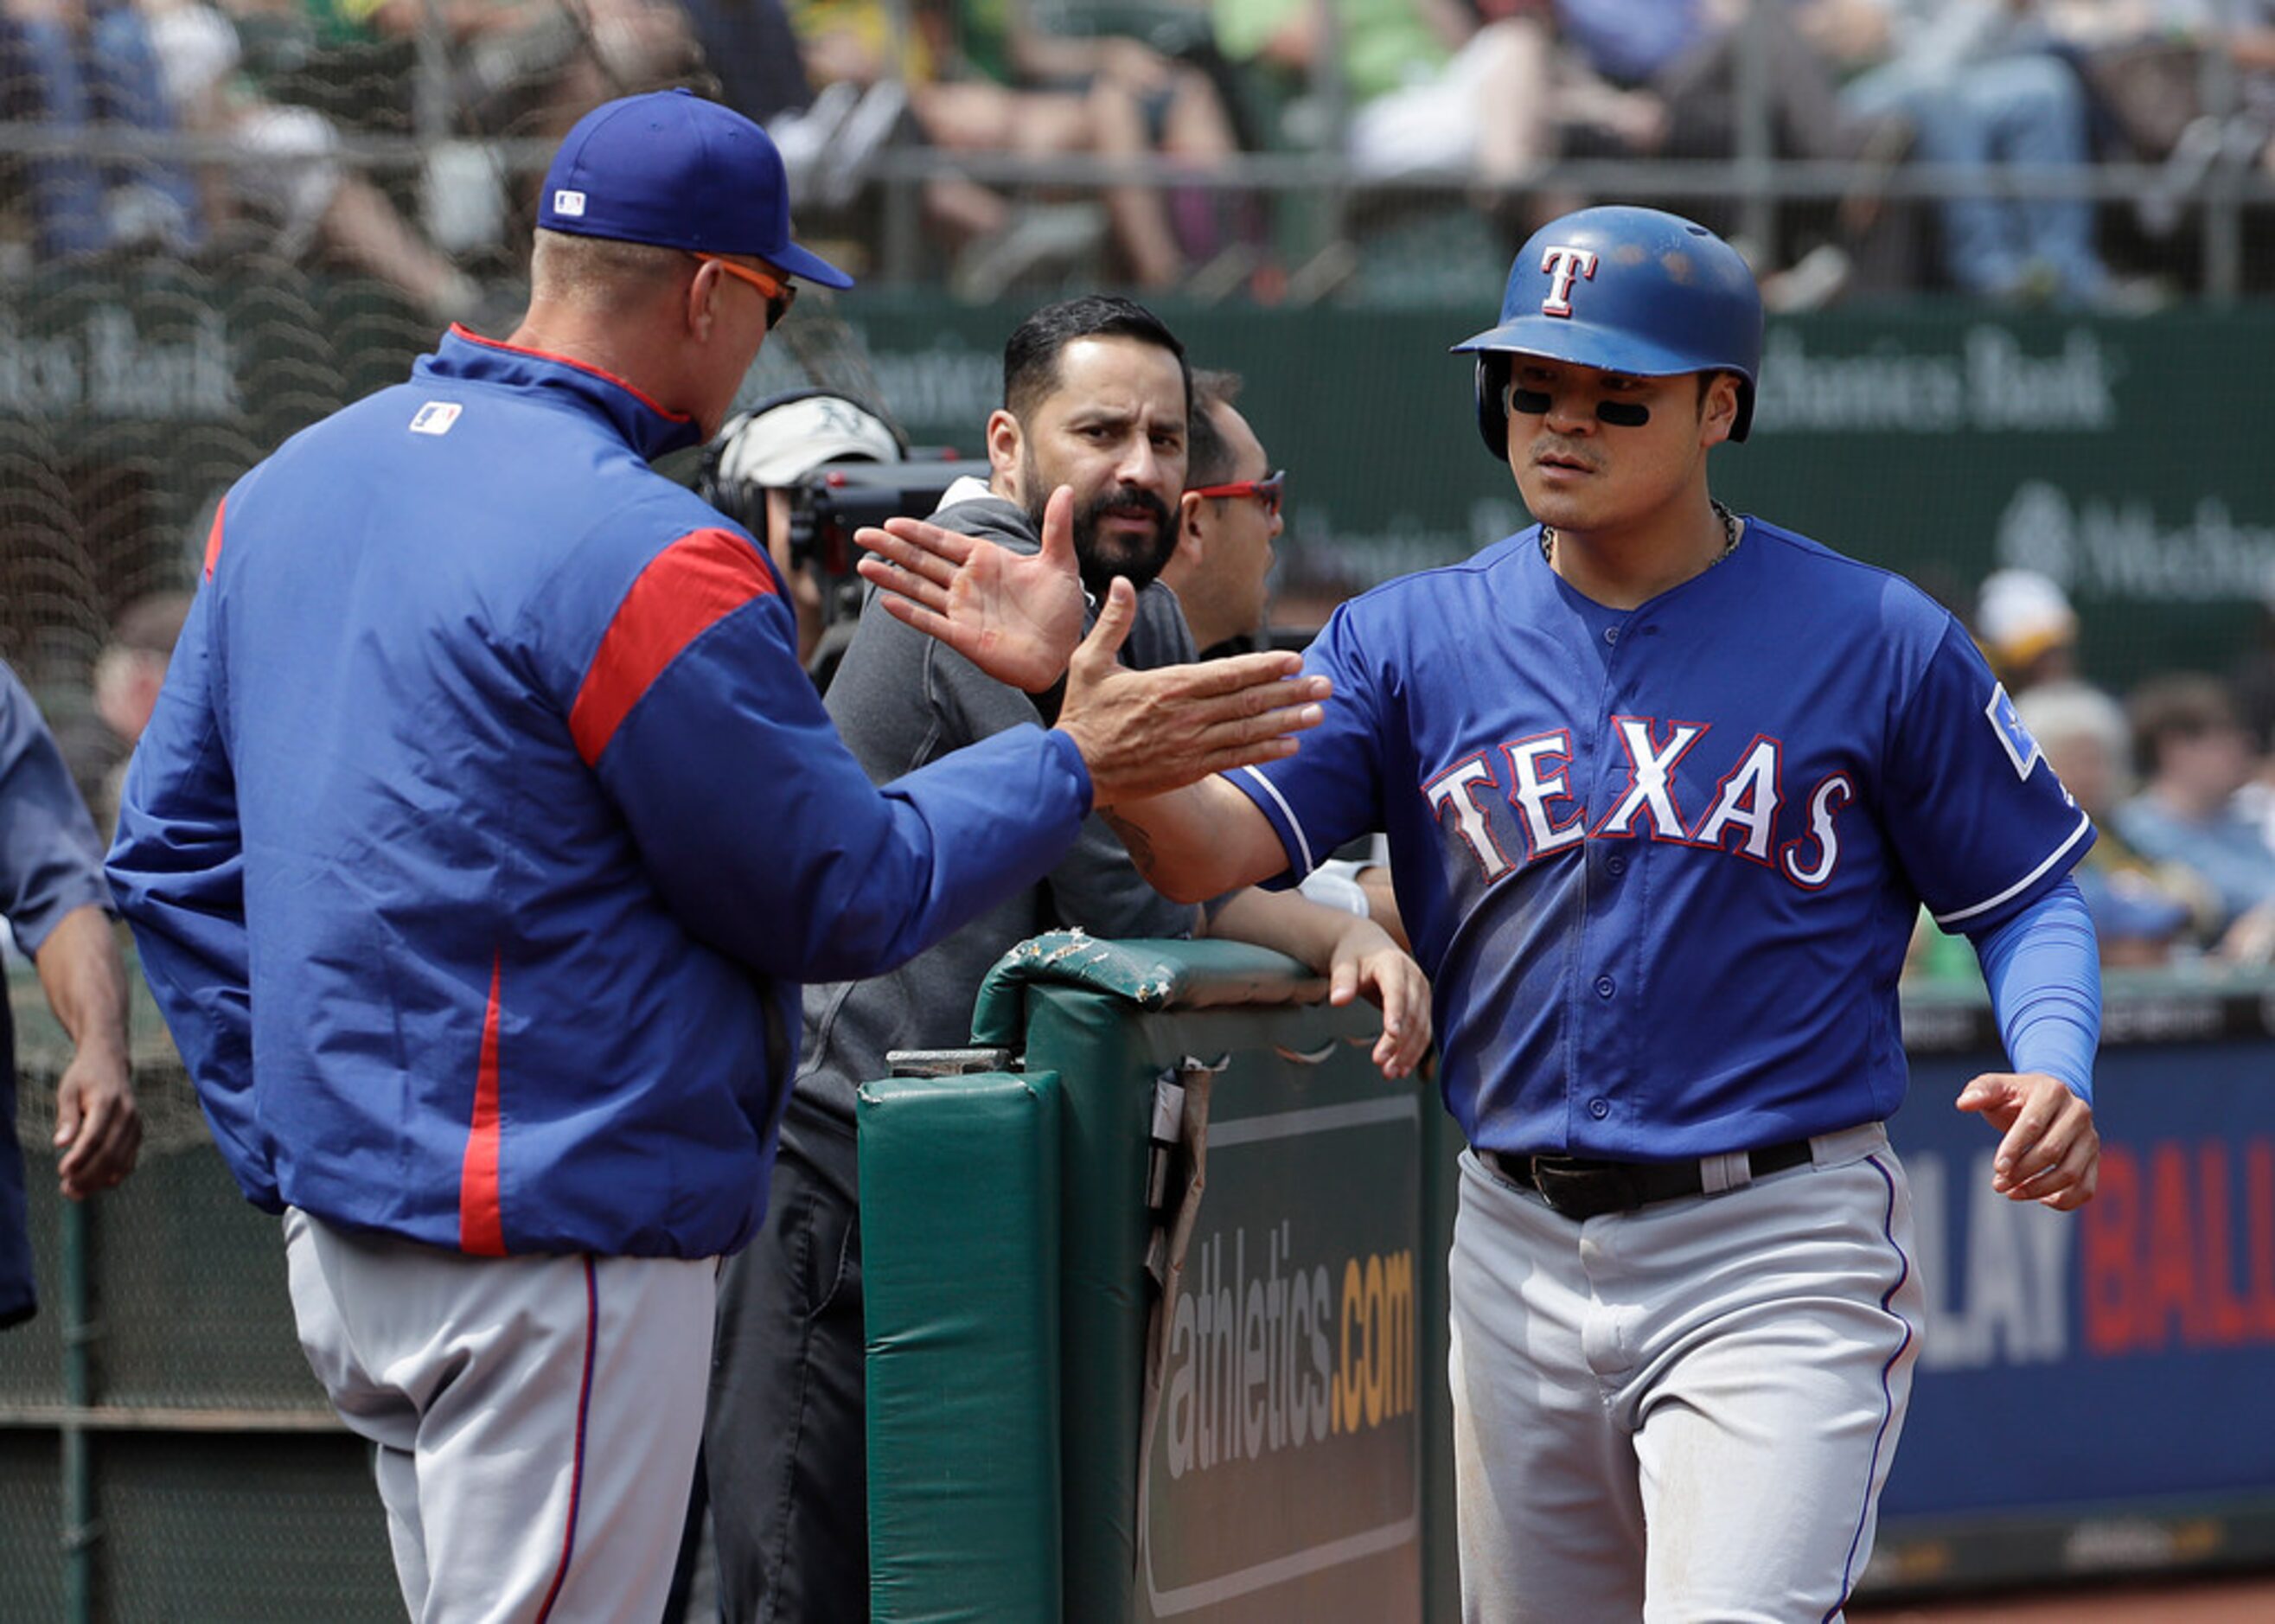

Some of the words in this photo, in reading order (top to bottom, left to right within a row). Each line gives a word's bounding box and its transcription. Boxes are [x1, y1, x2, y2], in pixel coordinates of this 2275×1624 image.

[1541, 245, 1598, 319] T
[1420, 715, 1856, 891] TEXAS
[2084, 1135, 2275, 1356] BALL
[1168, 1218, 1415, 1480] athletics.com
